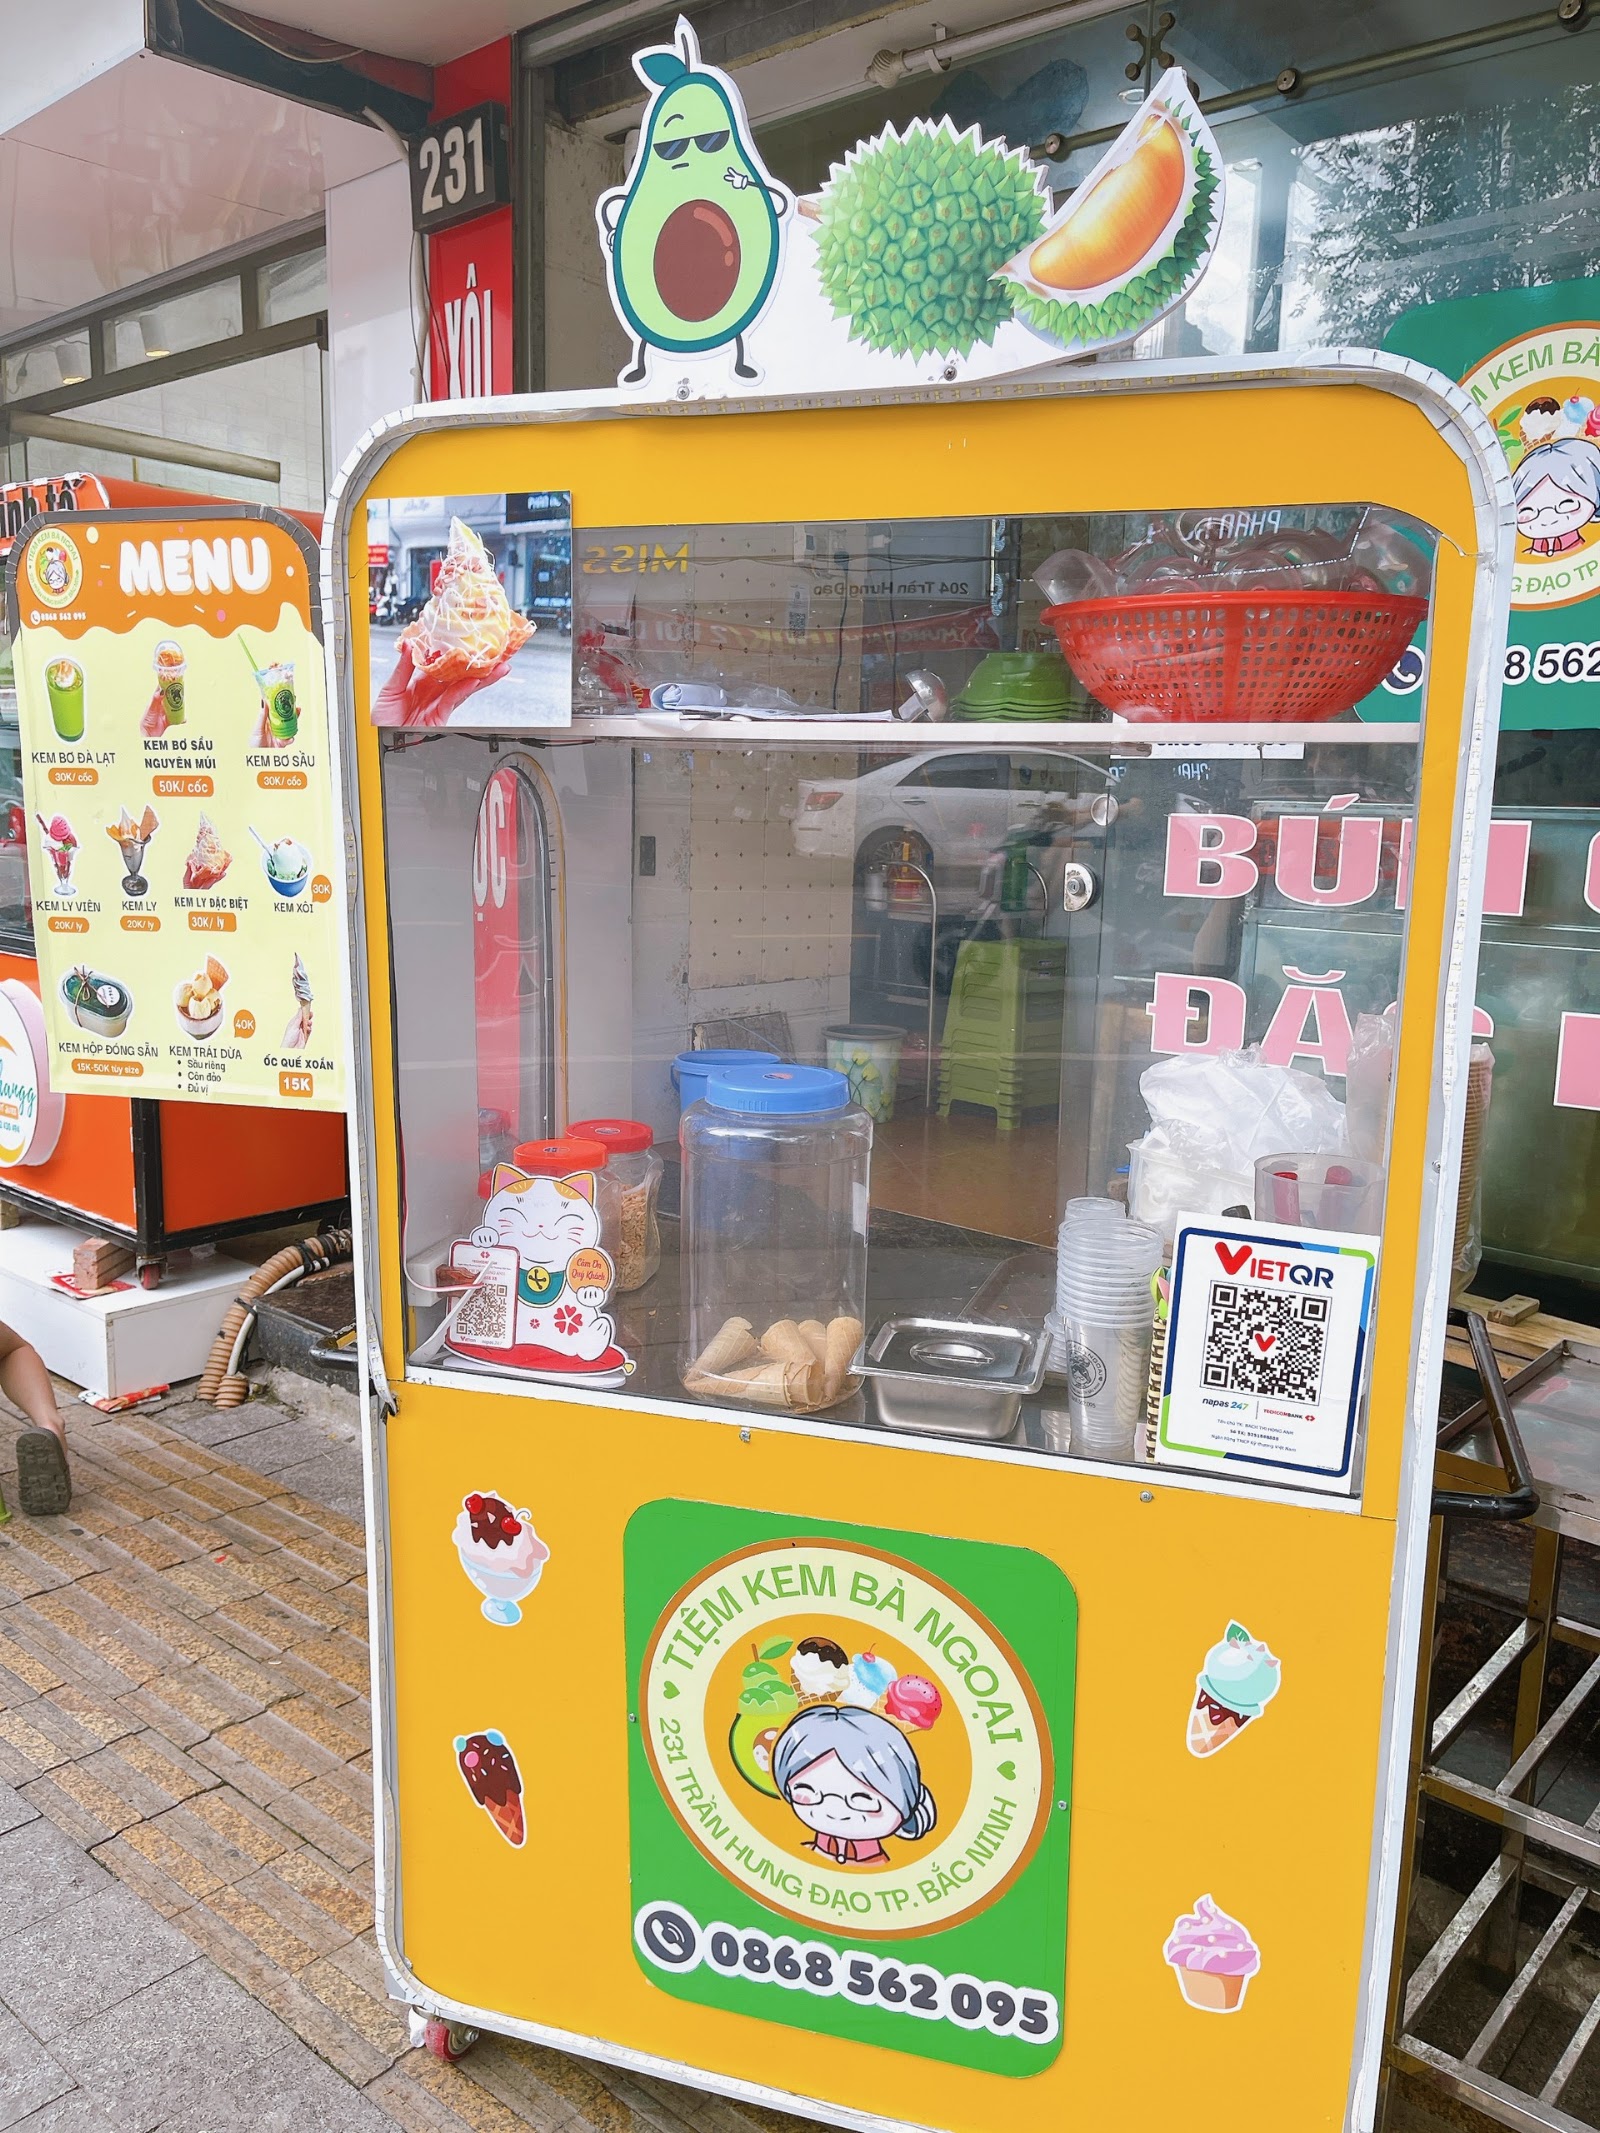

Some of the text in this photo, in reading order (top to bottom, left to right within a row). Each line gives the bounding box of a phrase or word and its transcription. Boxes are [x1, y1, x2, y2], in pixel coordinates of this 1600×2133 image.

[419, 117, 485, 214] 231
[1488, 336, 1600, 391] KEM BÀ
[119, 537, 270, 595] MENU
[1526, 572, 1571, 595] ĐẠO
[1538, 646, 1600, 678] 562
[144, 740, 168, 750] KEM
[172, 738, 188, 750] BƠ
[31, 748, 116, 767] KEM BƠ ĐÀ LẠT
[144, 755, 216, 768] NGUYÊN MÚI
[246, 750, 315, 767] KEM BƠ SẦU
[55, 772, 76, 782] 30K/
[264, 775, 286, 786] 30K/
[159, 778, 208, 793] 50K/ cốc
[312, 884, 331, 895] 30K
[36, 899, 101, 912] KEM LY VIÊN
[122, 901, 157, 911] KEM LY
[174, 896, 248, 911] KEM LY ĐẶC BIỆT
[274, 901, 314, 913] KEM XÔI
[54, 921, 83, 932] 20K/ ly
[126, 919, 155, 931] 20K/ ly
[191, 917, 225, 930] 30K/ ly
[235, 1019, 254, 1030] 40K
[59, 1042, 159, 1057] KEM HỘP ĐÓNG SẴN
[169, 1045, 242, 1059] KEM TRÁI DỪA
[76, 1063, 110, 1073] 15K-50K
[125, 1066, 139, 1075] size
[187, 1059, 226, 1072] Sầu riêng
[263, 1054, 334, 1070] ỐC QUẾ XOẮN
[187, 1083, 208, 1096] Đủ vị
[283, 1077, 310, 1091] 15K
[1215, 1242, 1334, 1290] VIETQR
[1202, 1398, 1249, 1411] napas 247
[662, 1563, 1023, 1745] TIỆM KEM BÀ NGOẠI
[658, 1717, 1018, 1917] 231 TRẦN HƯNG ĐẠO TP. BẮC NINH
[710, 1932, 1050, 2036] 0868 562 095
